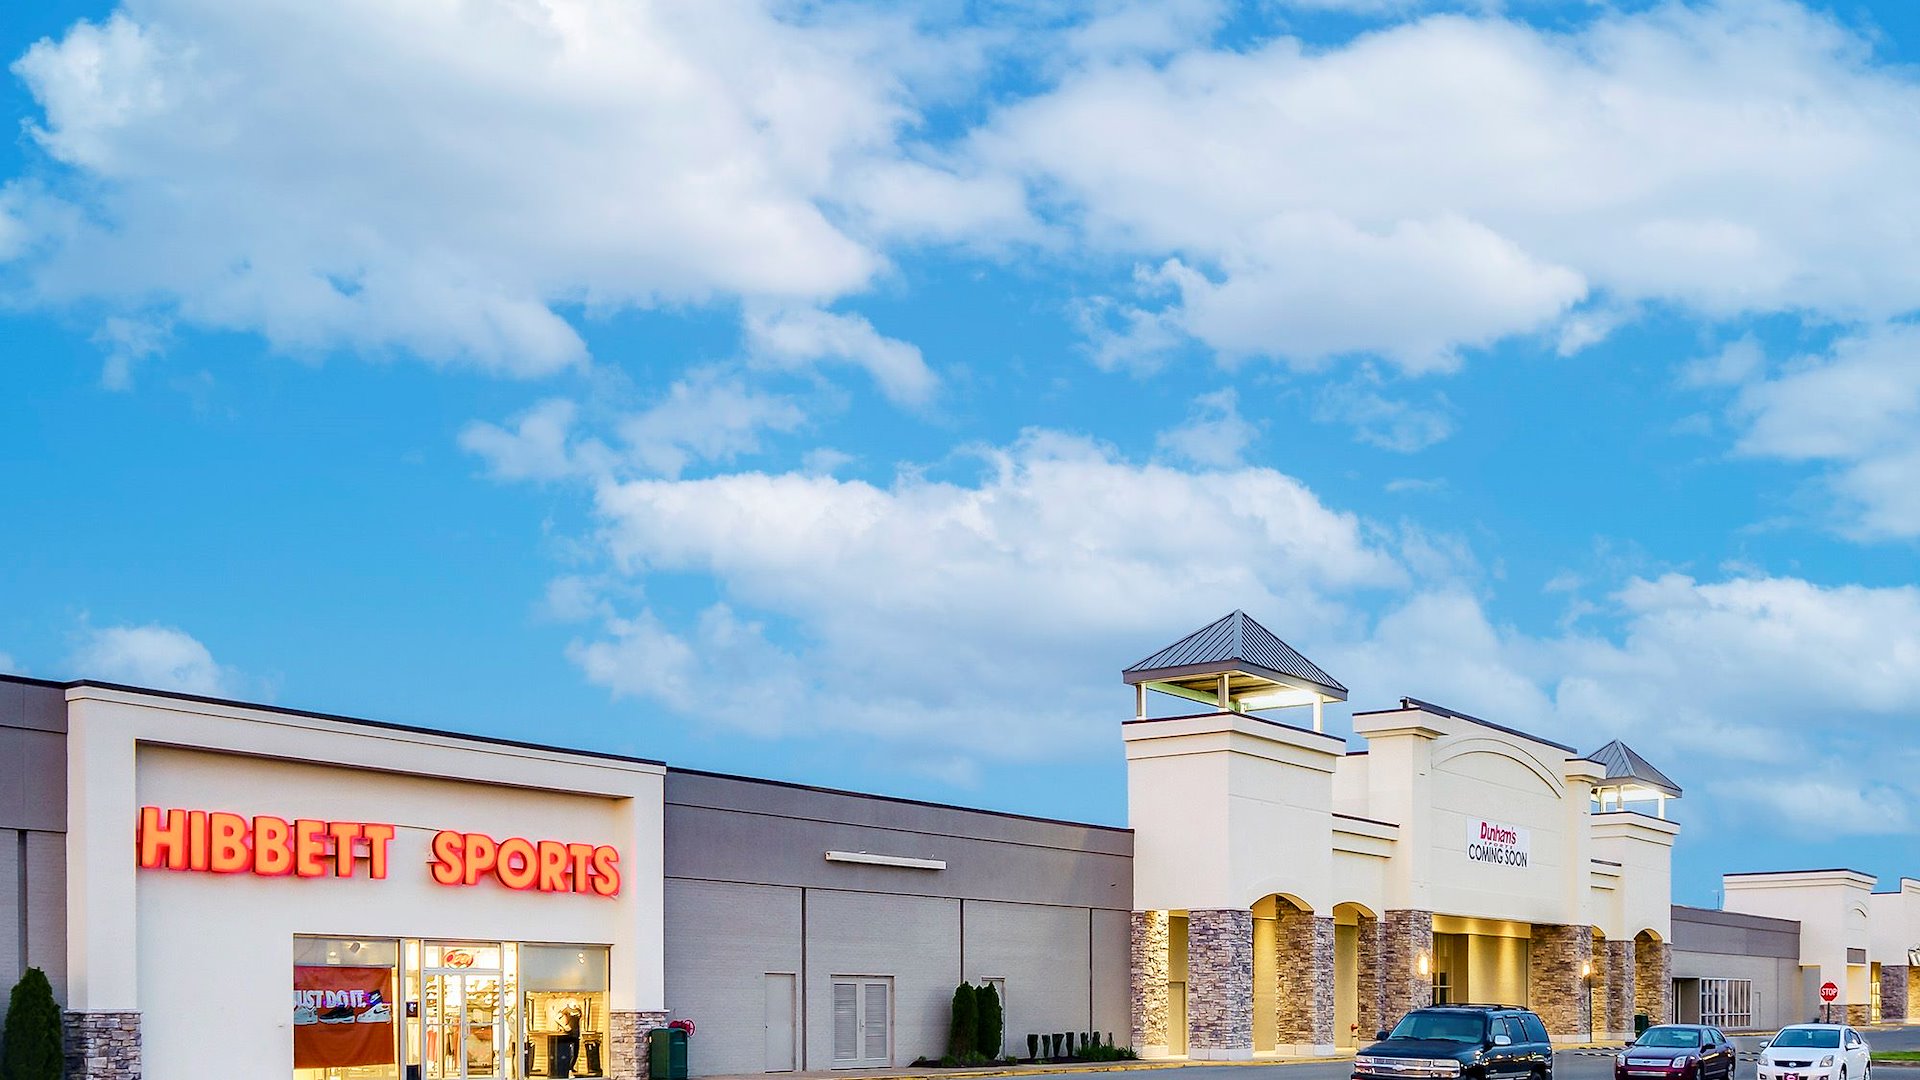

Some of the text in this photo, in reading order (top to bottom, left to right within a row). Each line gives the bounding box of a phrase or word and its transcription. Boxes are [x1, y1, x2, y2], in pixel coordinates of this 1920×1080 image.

[1480, 821, 1517, 845] Dunham's
[139, 806, 622, 897] HIBBETT SPORTS
[1468, 843, 1528, 868] COMING SOON
[325, 989, 349, 1009] DO
[1821, 987, 1838, 996] STOP
